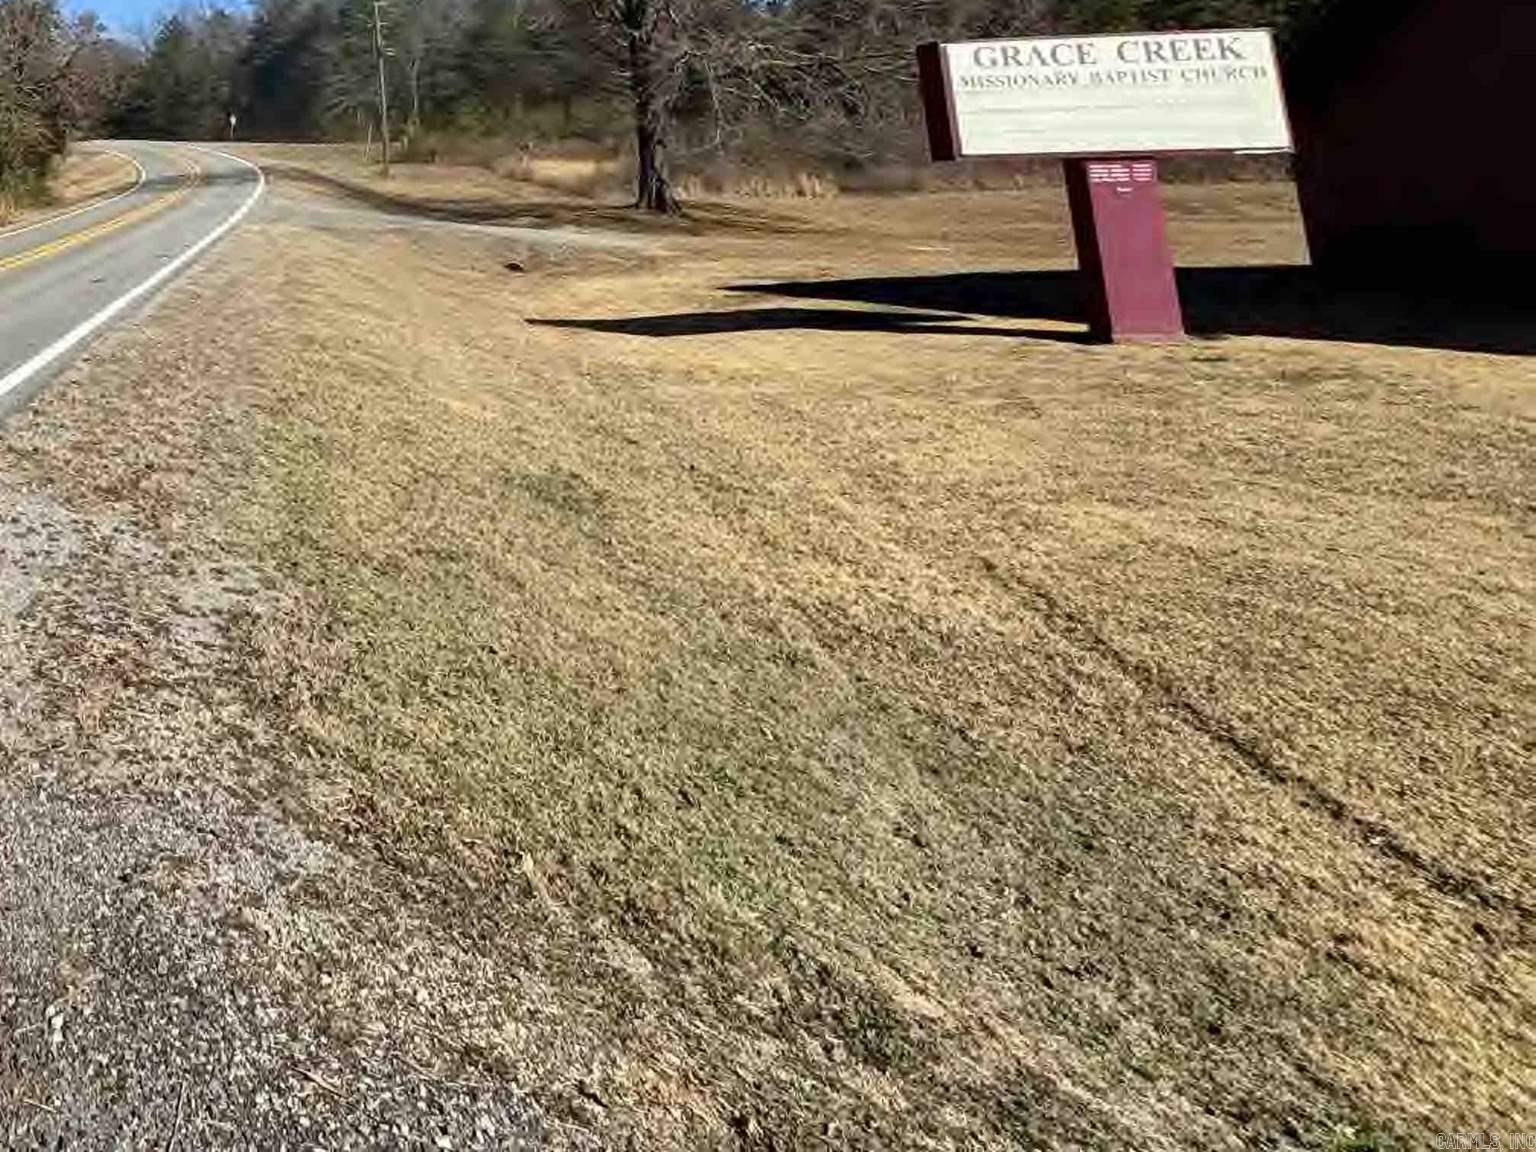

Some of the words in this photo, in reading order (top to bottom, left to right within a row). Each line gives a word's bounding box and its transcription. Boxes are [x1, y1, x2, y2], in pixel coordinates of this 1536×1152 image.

[972, 41, 1098, 69] GRACE
[1116, 36, 1248, 64] CREEK
[959, 70, 1079, 89] MISSIONARY
[1088, 67, 1173, 86] BAPTIST
[1180, 64, 1269, 83] CHURCH
